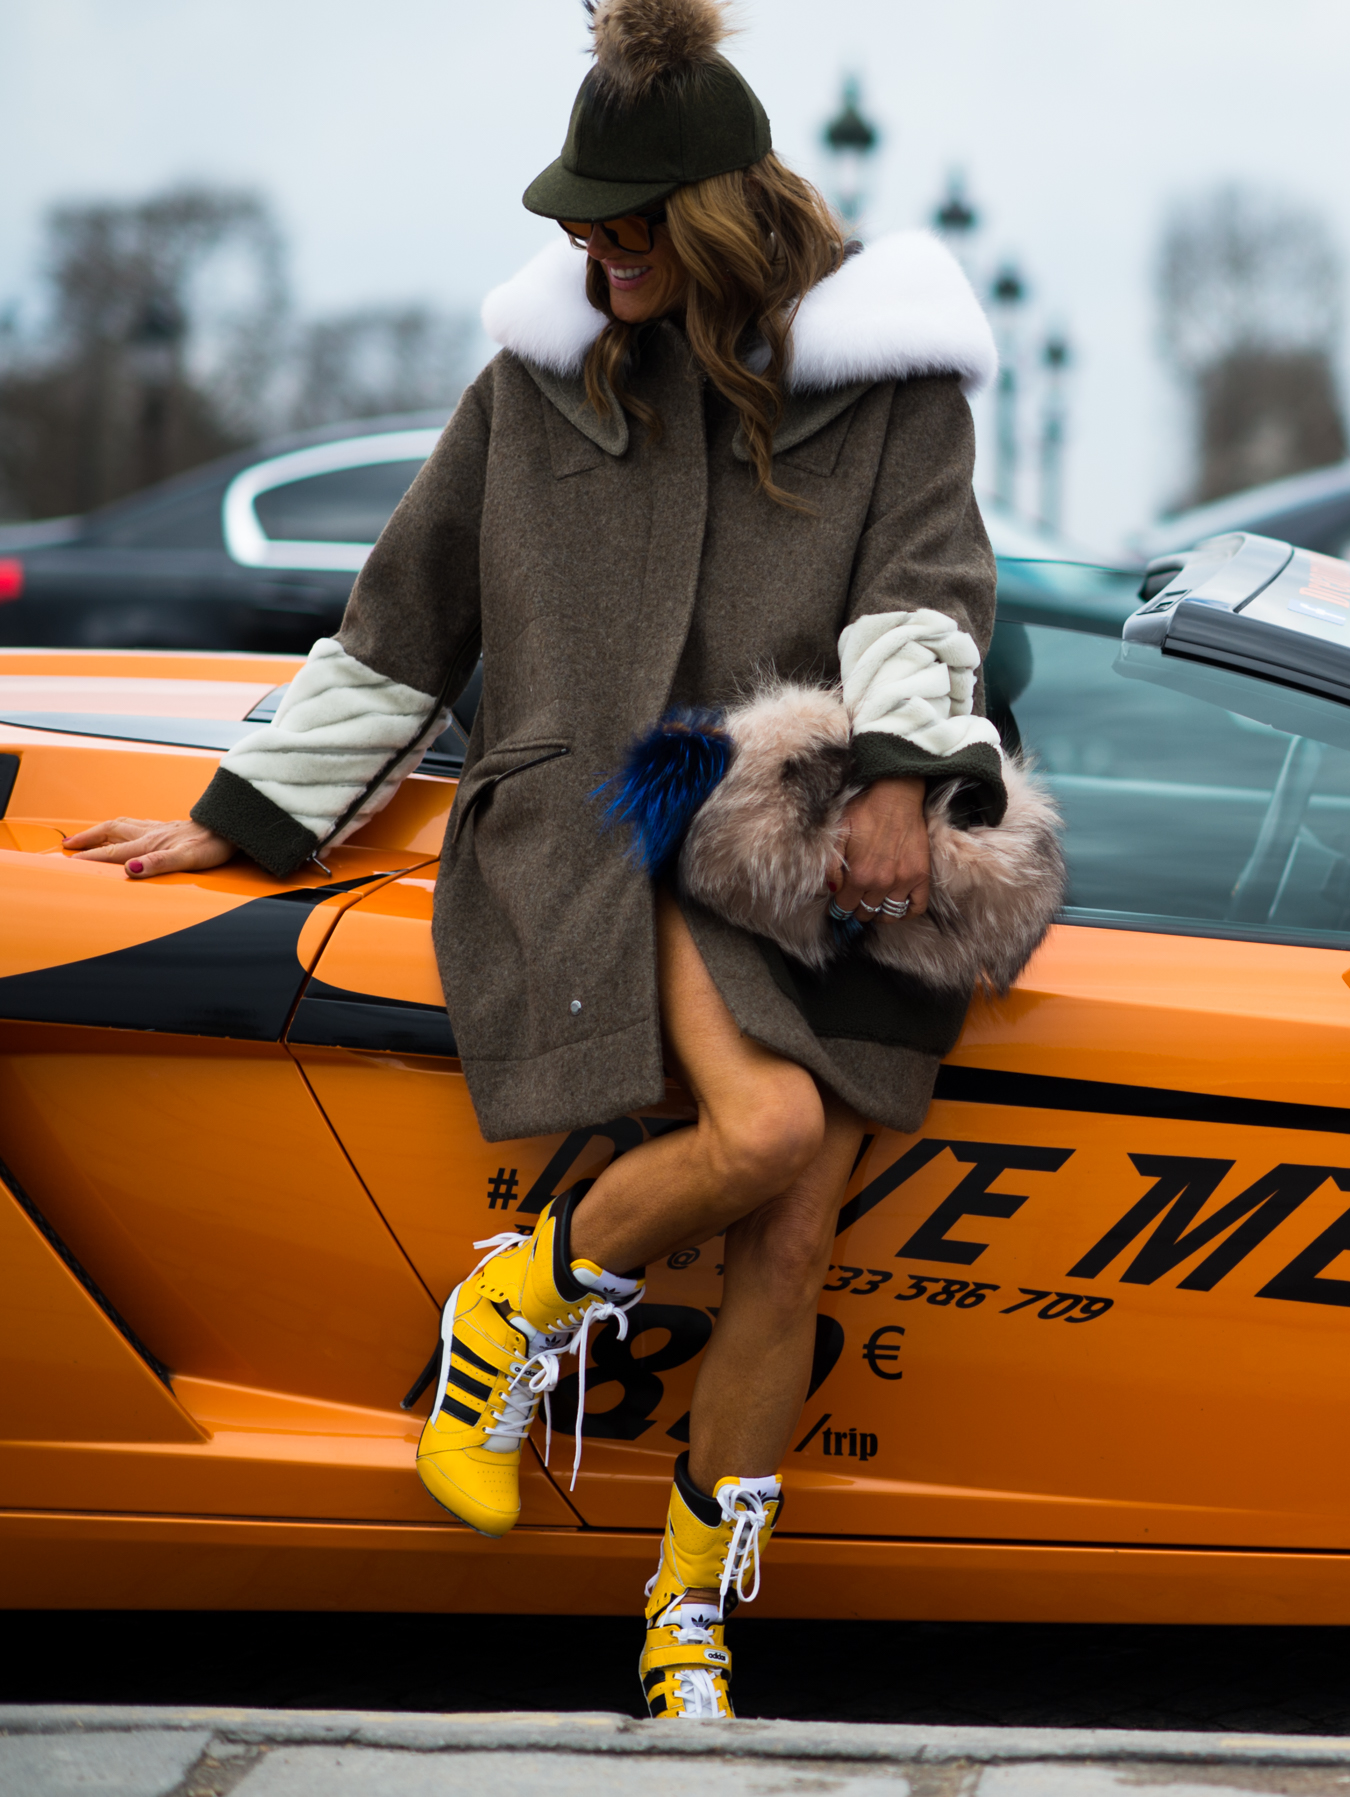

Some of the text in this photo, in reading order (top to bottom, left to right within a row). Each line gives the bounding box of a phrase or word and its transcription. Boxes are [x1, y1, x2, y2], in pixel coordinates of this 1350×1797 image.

[666, 1247, 701, 1270] @
[894, 1274, 1001, 1309] 586
[998, 1288, 1115, 1324] 709
[862, 1325, 906, 1380] €
